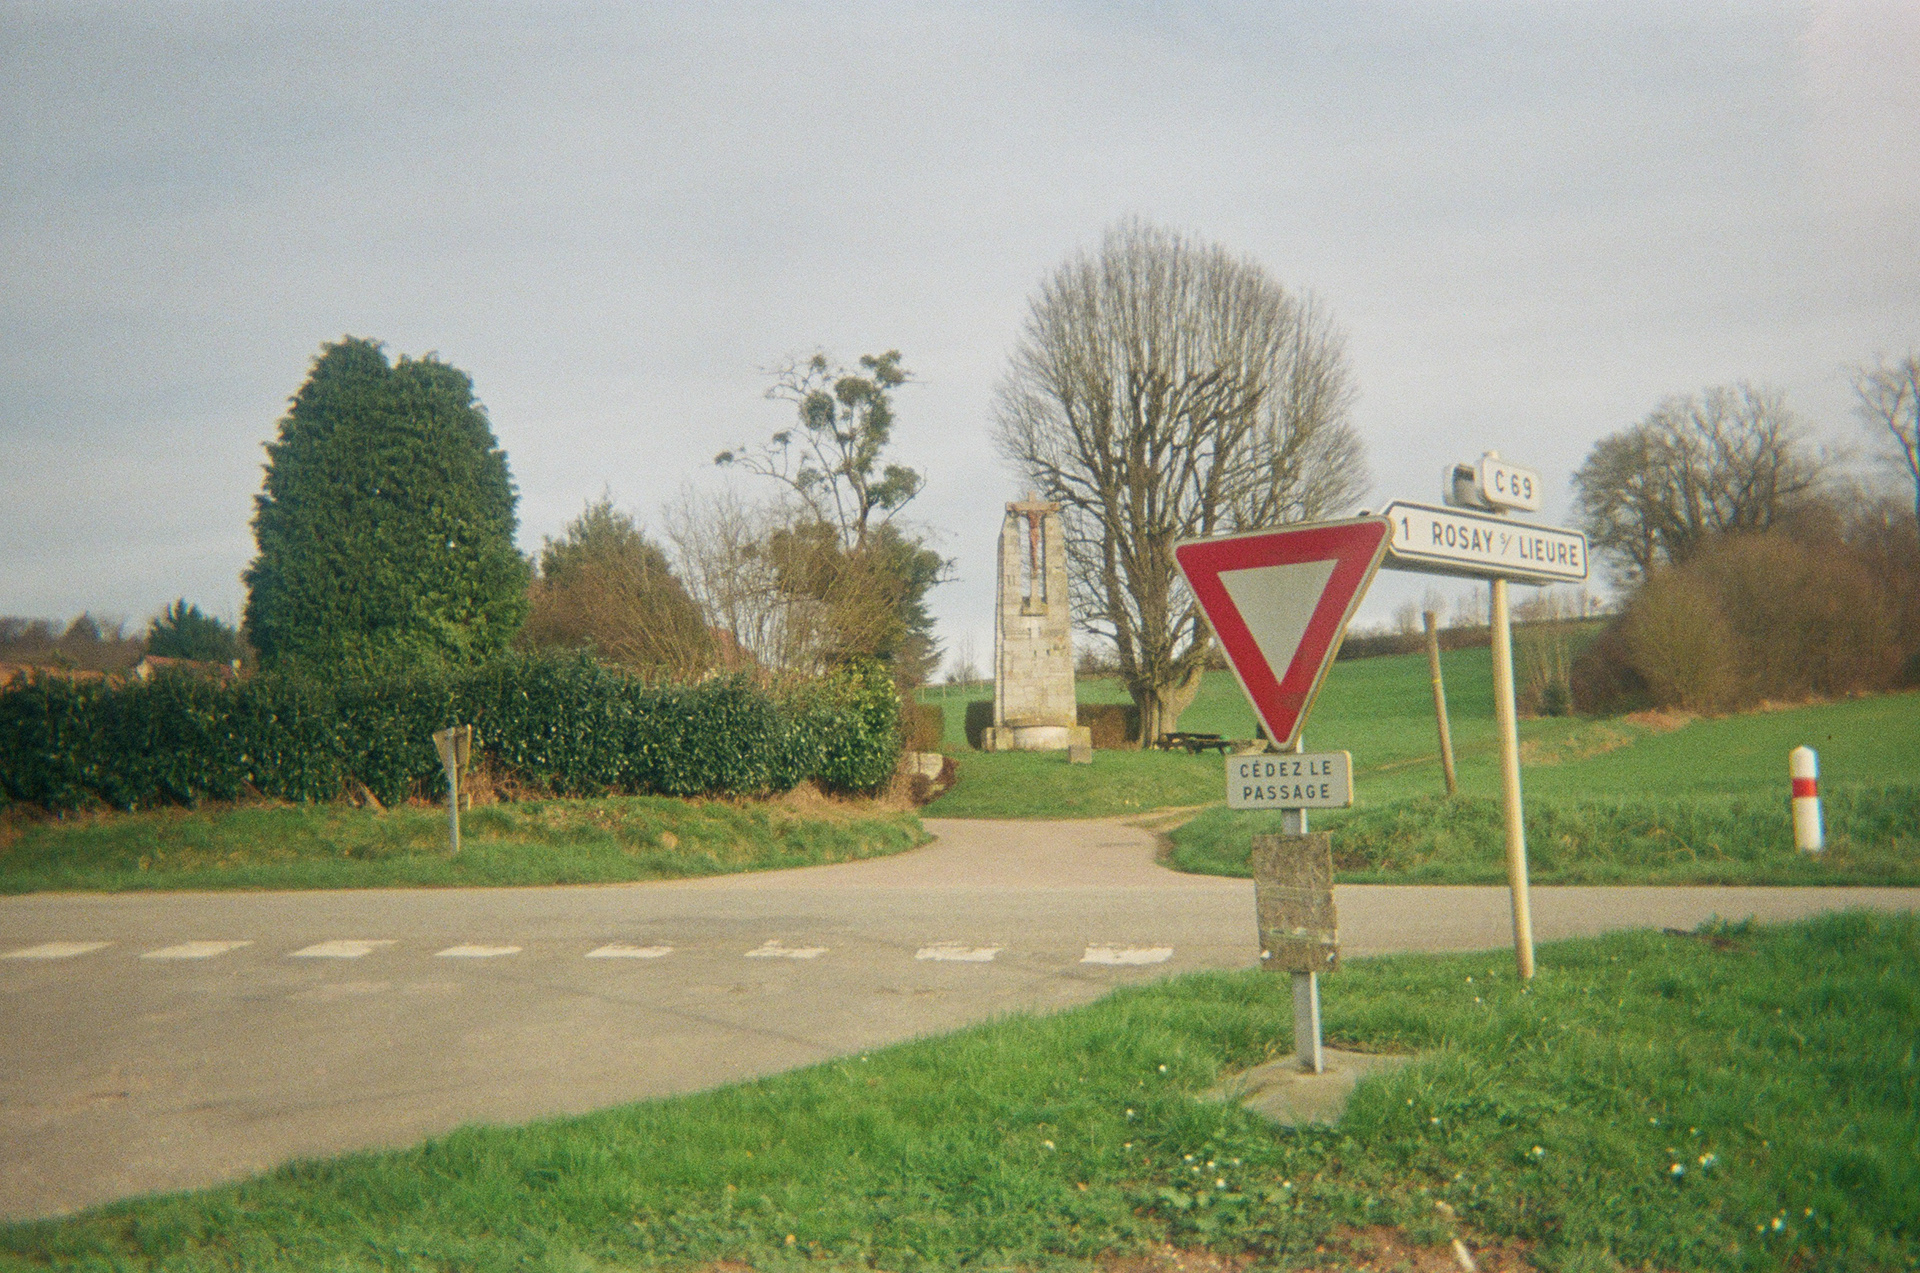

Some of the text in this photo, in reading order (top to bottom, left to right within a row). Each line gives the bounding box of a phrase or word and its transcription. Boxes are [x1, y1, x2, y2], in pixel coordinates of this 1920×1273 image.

[1495, 470, 1532, 500] C 69
[1401, 517, 1409, 541] 1
[1432, 521, 1493, 553] ROSAY
[1518, 536, 1579, 567] LIEURE
[1240, 760, 1331, 778] CÉDEZ LE
[1243, 783, 1330, 800] PASSAGE
